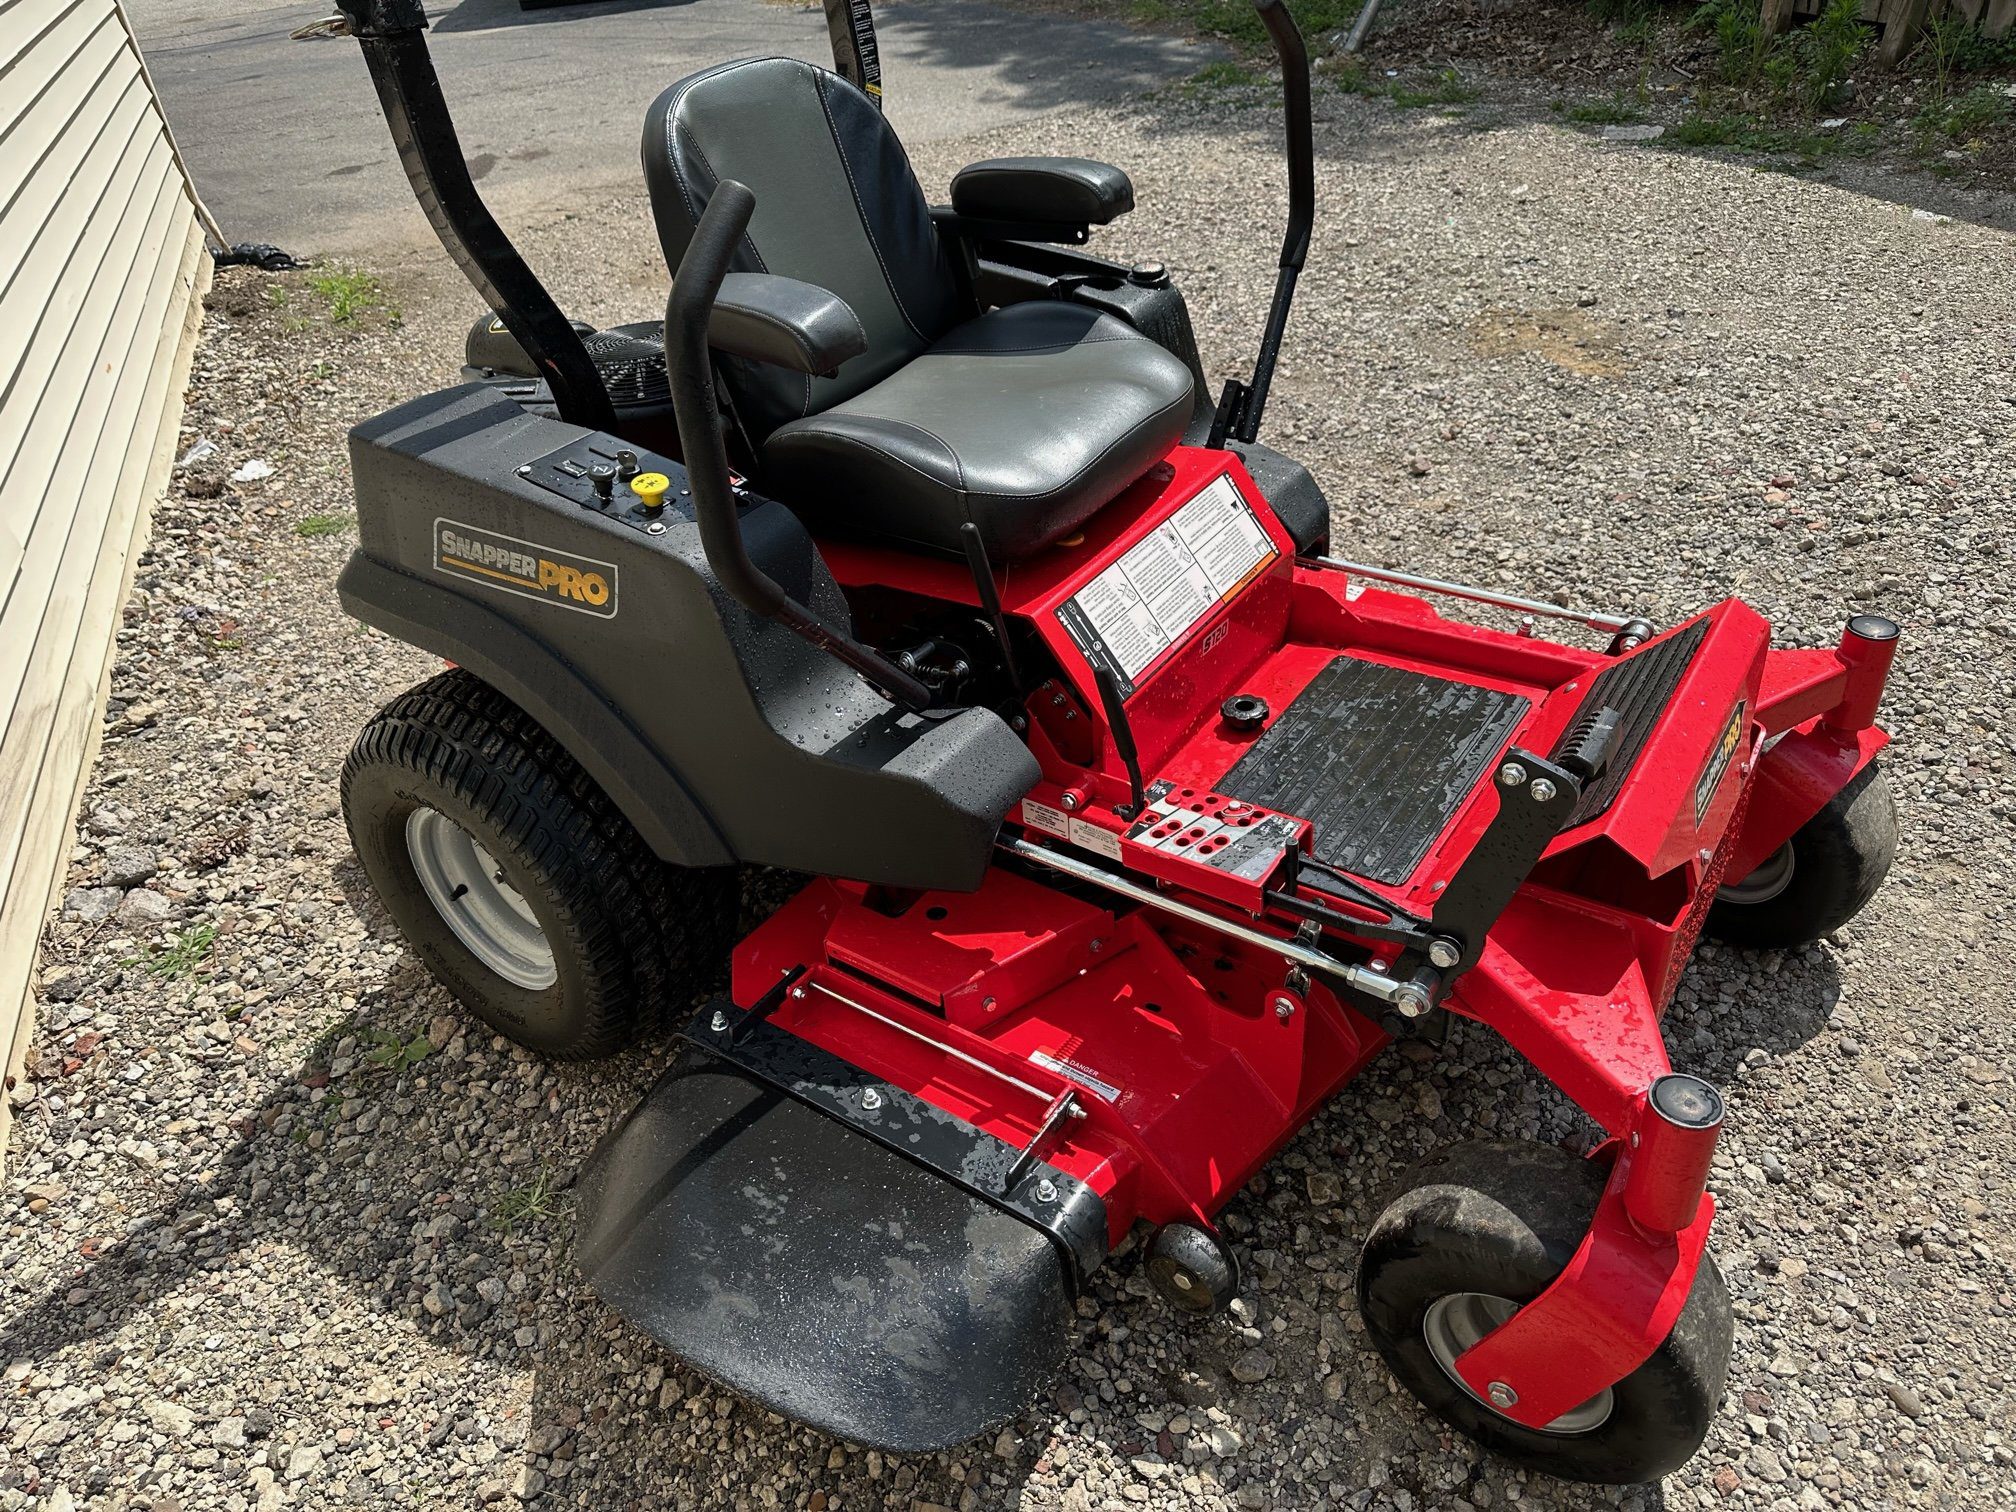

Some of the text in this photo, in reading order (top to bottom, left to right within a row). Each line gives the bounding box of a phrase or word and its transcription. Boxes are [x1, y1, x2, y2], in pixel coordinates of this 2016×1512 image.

[441, 530, 609, 606] SNAPPER PRO
[1069, 1060, 1099, 1077] DANGER
